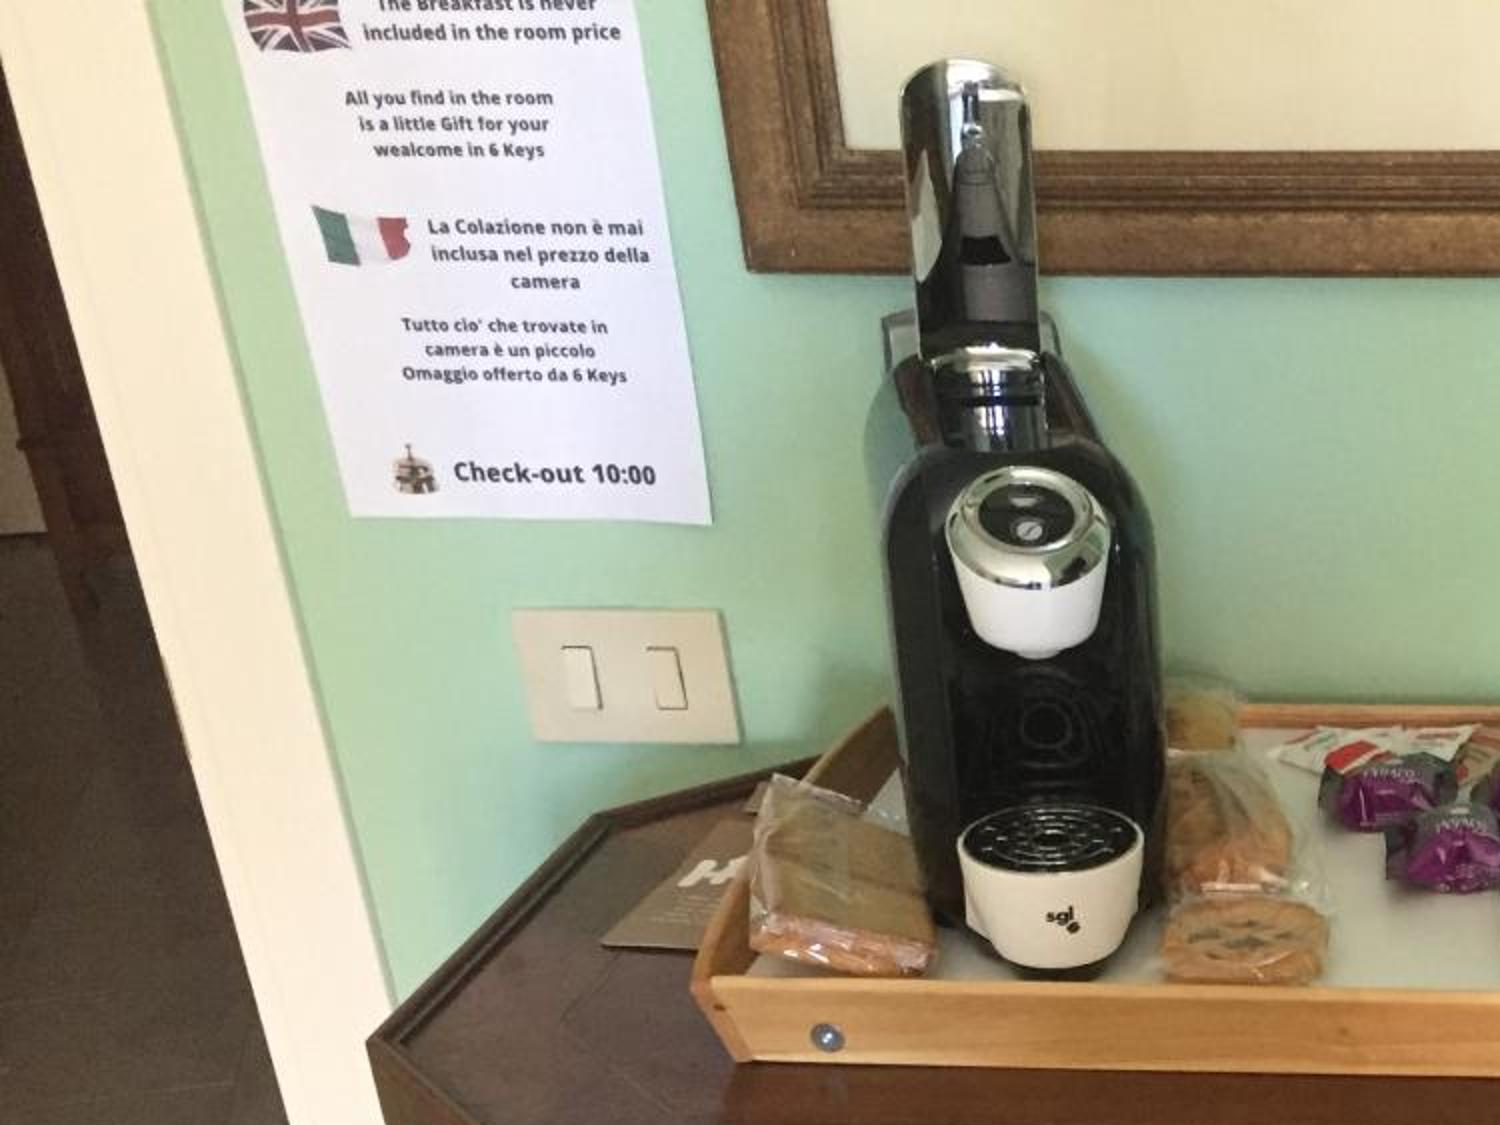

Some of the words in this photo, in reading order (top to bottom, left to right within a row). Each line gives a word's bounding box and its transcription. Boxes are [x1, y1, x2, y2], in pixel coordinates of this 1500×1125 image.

[417, 0, 514, 11] Breakfast
[541, 0, 596, 11] never
[362, 23, 447, 41] included
[450, 23, 471, 41] in
[476, 24, 509, 41] the
[514, 27, 567, 41] room
[572, 23, 621, 44] price
[345, 90, 369, 106] All
[373, 93, 406, 110] you
[411, 90, 445, 105] find
[450, 90, 467, 105] in
[471, 90, 501, 105] the
[505, 93, 553, 105] room
[358, 116, 375, 131] is
[379, 119, 389, 131] a
[393, 116, 436, 131] little
[441, 116, 474, 131] Gift
[478, 116, 503, 131] for
[507, 119, 549, 135] your
[373, 142, 463, 157] wealcome
[467, 142, 485, 157] in
[489, 143, 499, 157] 6
[503, 143, 545, 161] Keys
[428, 219, 450, 235] La
[455, 218, 546, 235] Colazione
[551, 222, 587, 235] non
[593, 219, 603, 235] è
[608, 219, 643, 236] mai
[431, 245, 498, 262] inclusa
[504, 246, 533, 262] nel
[538, 249, 599, 266] prezzo
[604, 247, 650, 263] della
[511, 276, 580, 290] camera
[401, 318, 449, 332] Tutto
[488, 318, 518, 333] che
[523, 320, 587, 333] trovate
[592, 320, 608, 334] in
[425, 344, 489, 357] camera
[494, 343, 504, 358] è
[508, 345, 530, 358] un
[536, 344, 596, 362] piccolo
[402, 366, 478, 384] Omaggio
[482, 366, 543, 382] offerto
[547, 368, 568, 382] da
[573, 368, 583, 382] 6
[587, 369, 628, 387] Keys
[454, 461, 585, 484] Check-out
[592, 464, 656, 485] 10:00
[1045, 904, 1074, 927] sgl
